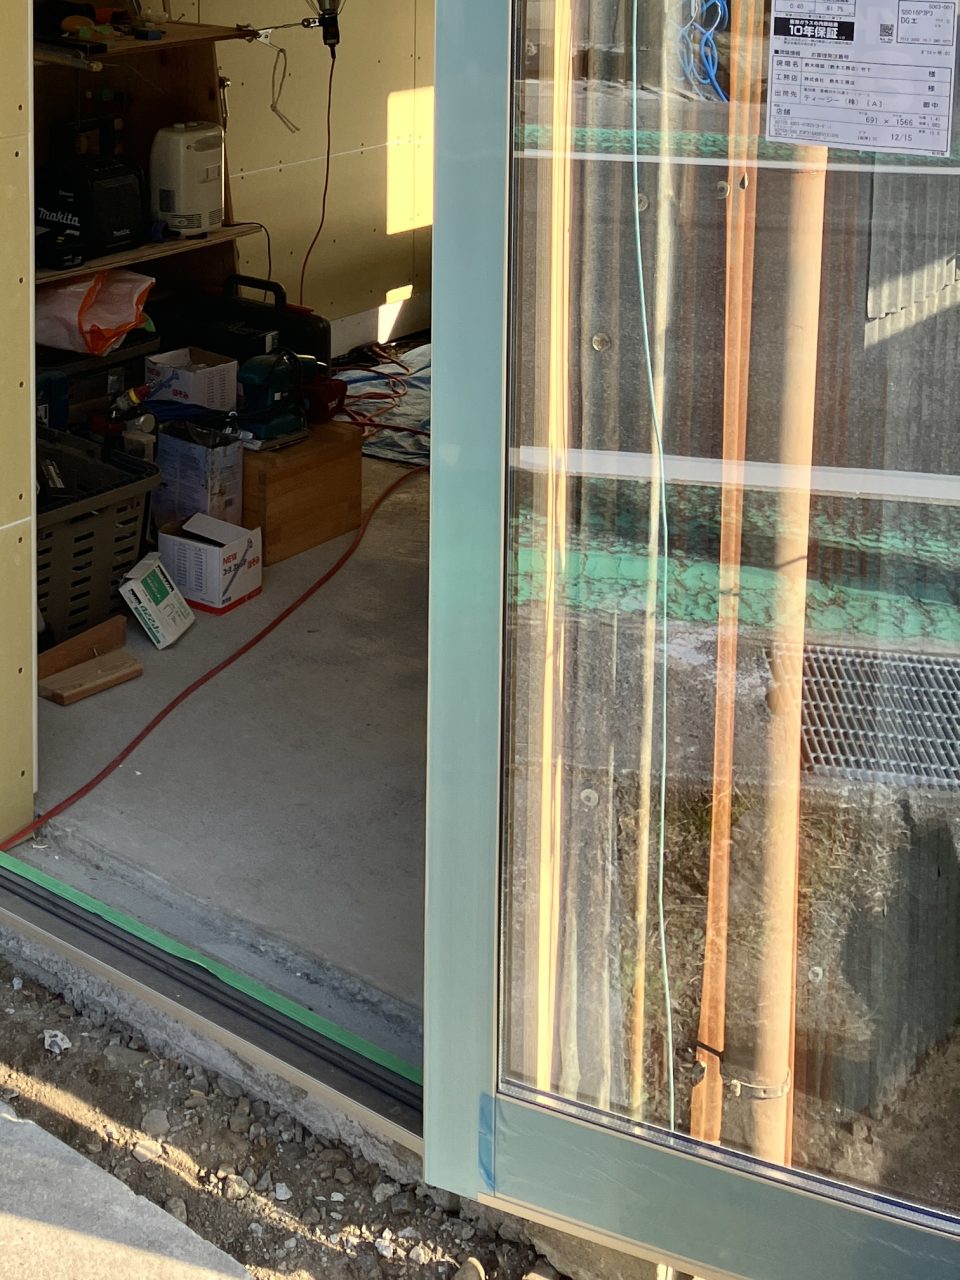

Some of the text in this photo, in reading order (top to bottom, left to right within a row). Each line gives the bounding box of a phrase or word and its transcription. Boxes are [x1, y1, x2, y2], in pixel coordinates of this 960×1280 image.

[789, 25, 838, 39] 10年保証
[865, 116, 878, 124] 691
[896, 118, 914, 126] 1566
[891, 133, 913, 142] 12/15
